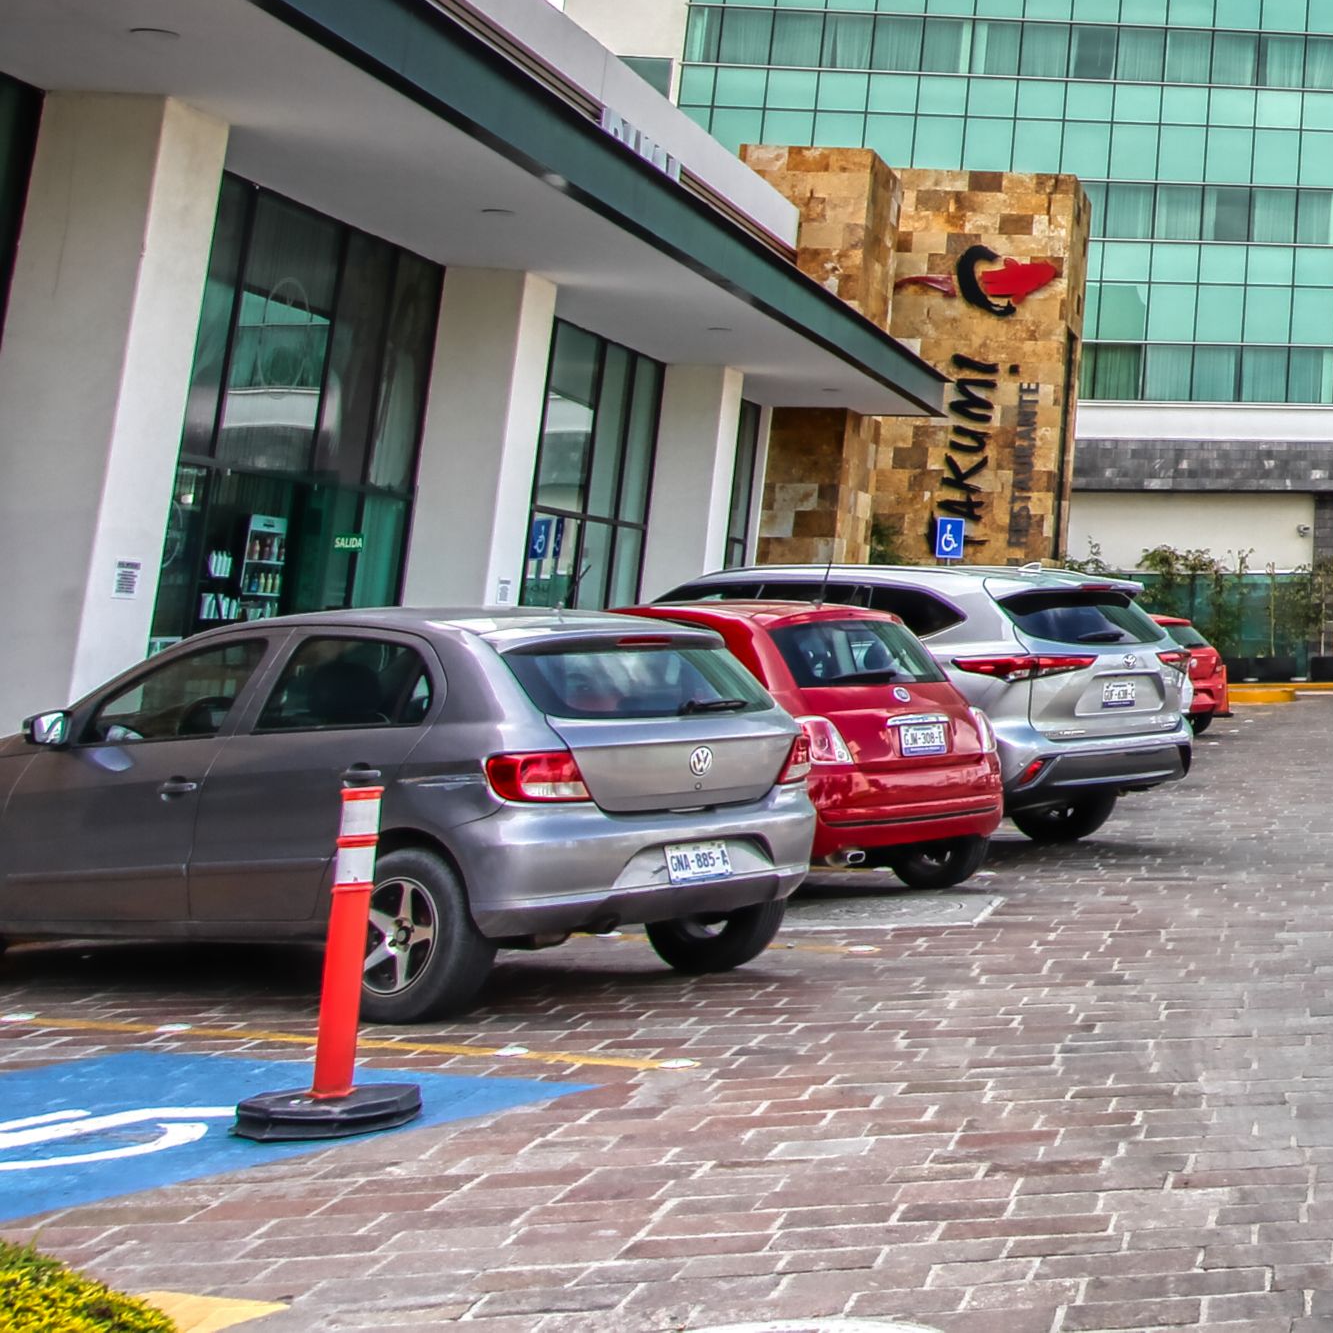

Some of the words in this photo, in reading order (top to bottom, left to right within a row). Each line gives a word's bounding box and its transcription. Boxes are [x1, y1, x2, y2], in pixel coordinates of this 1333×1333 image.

[1007, 381, 1040, 547] RESTAURANTE
[334, 537, 362, 548] SALIDA
[670, 849, 730, 872] GNA-885-A
